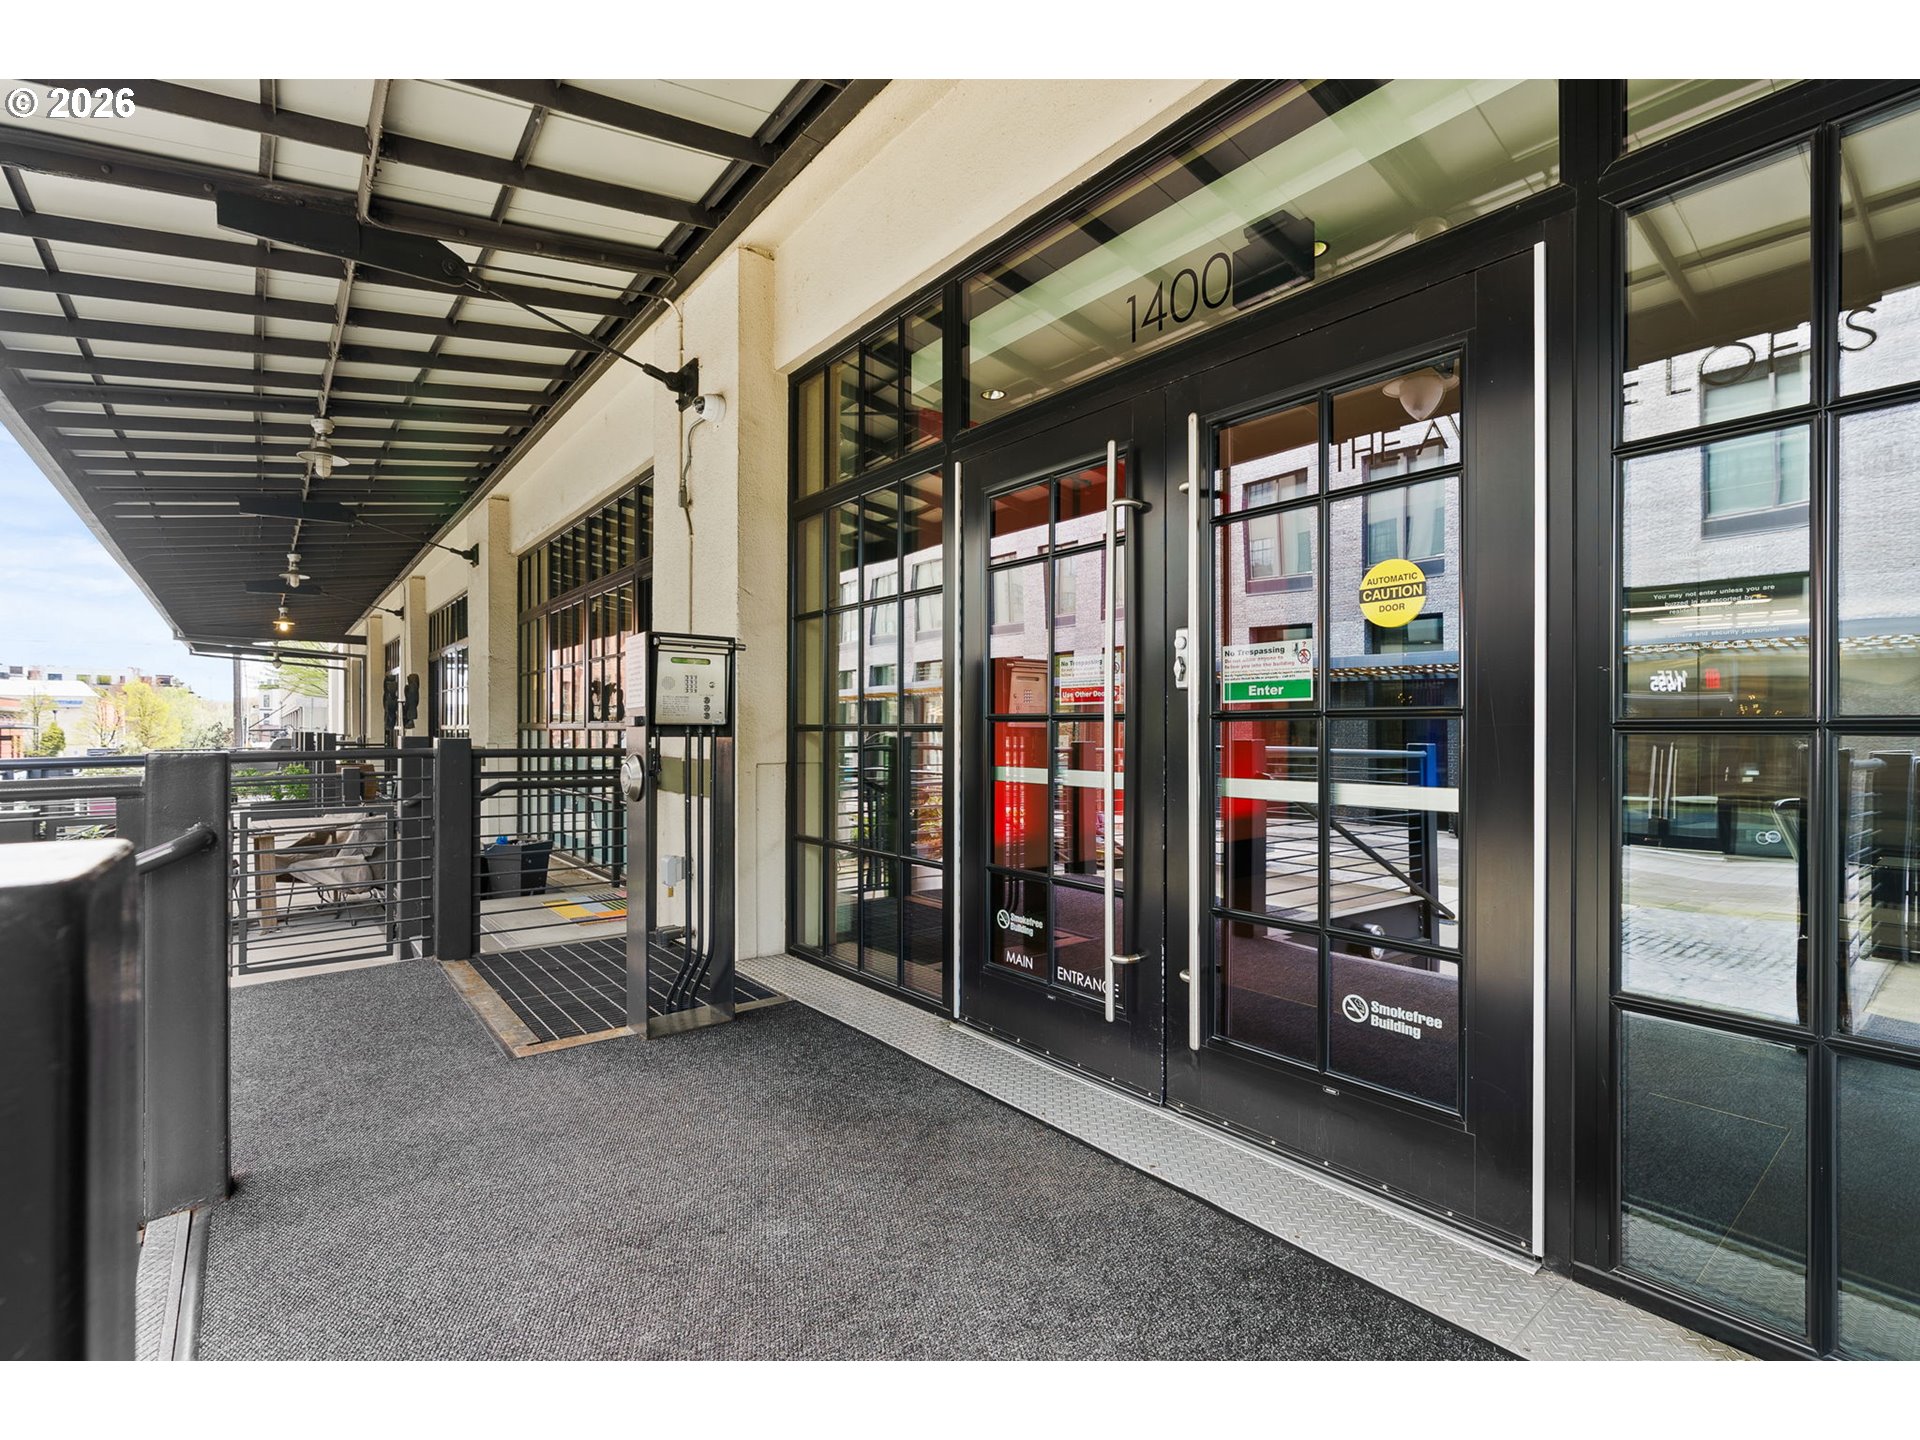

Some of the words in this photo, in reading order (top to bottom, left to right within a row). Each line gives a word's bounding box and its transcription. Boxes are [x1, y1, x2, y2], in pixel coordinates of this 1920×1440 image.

[1126, 252, 1232, 343] 1400
[1367, 571, 1418, 586] AUTOMATIC
[1362, 584, 1423, 602] CAUTION
[1378, 602, 1405, 613] DOOR
[1238, 647, 1285, 656] Trespassing
[1074, 690, 1092, 698] Other
[1249, 685, 1284, 696] Enter
[1010, 912, 1043, 929] Smokefree
[1010, 922, 1034, 938] Building
[1006, 950, 1033, 970] MAIN
[1370, 1000, 1443, 1029] Smokefree
[1370, 1014, 1421, 1040] Building
